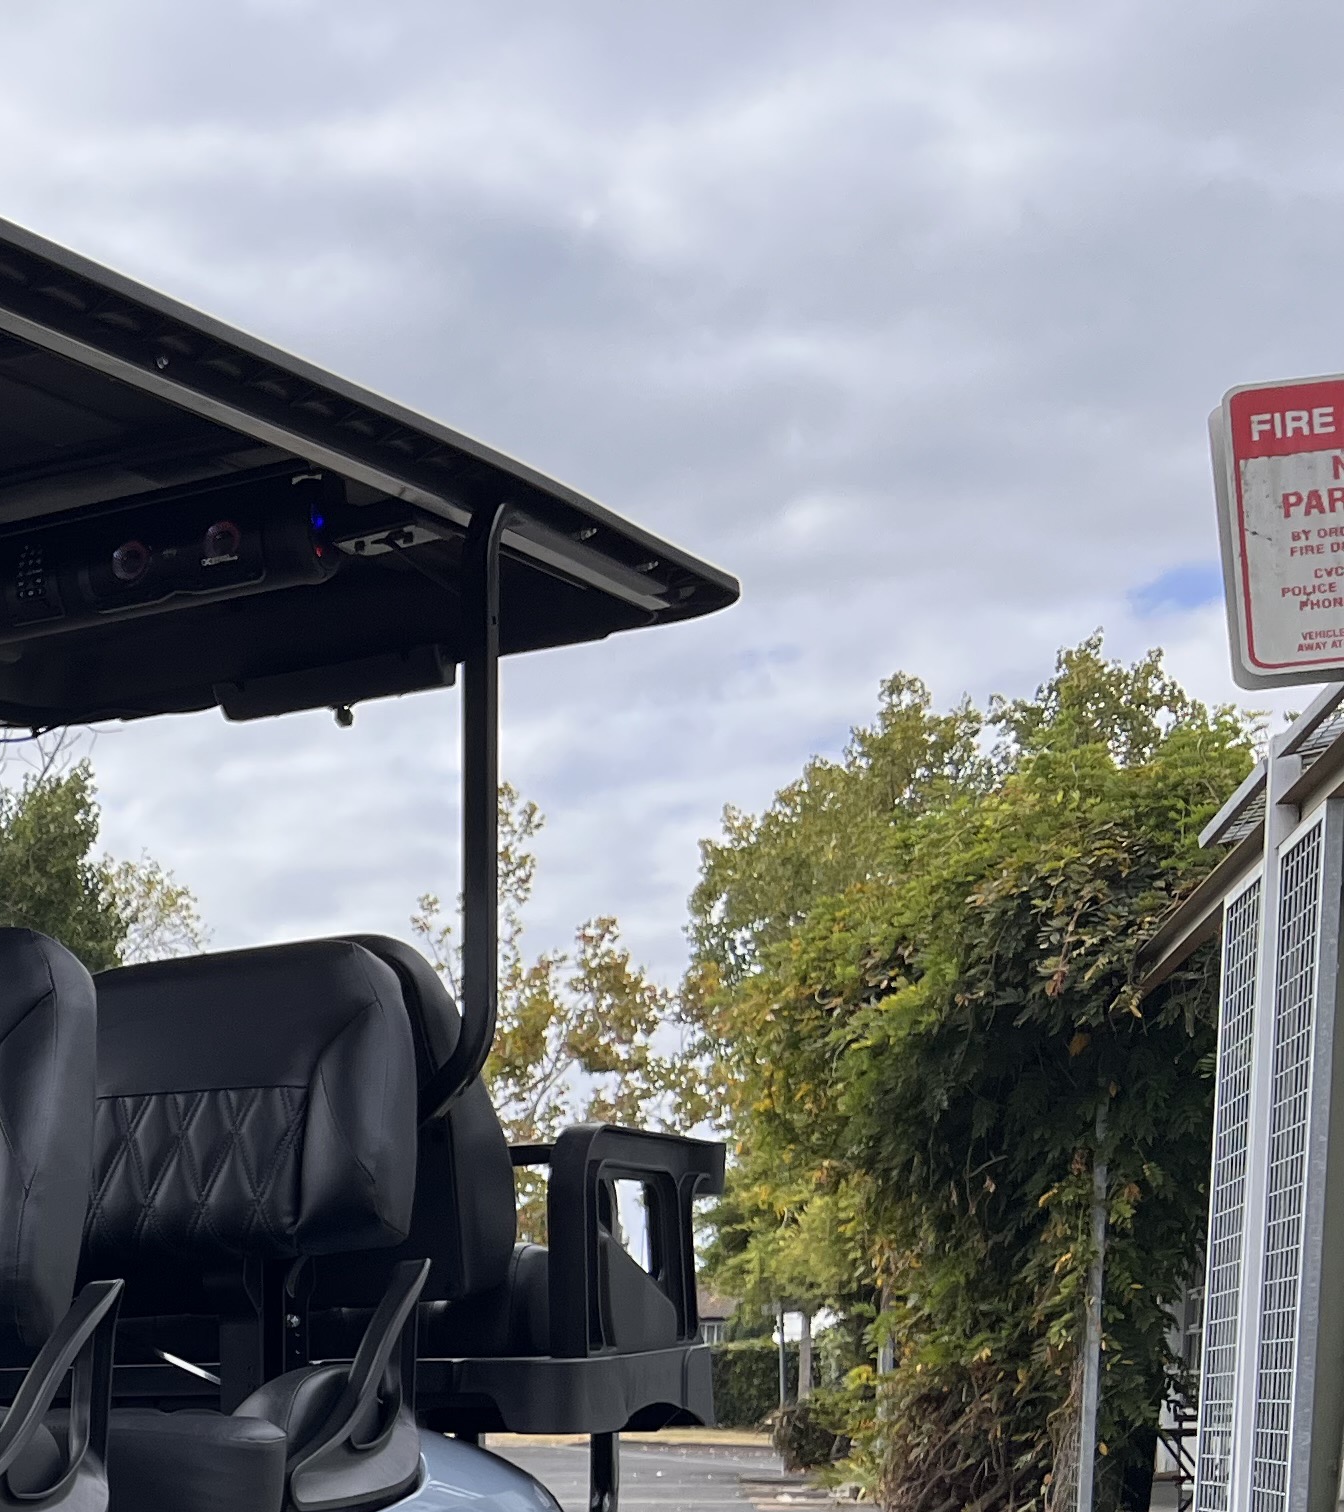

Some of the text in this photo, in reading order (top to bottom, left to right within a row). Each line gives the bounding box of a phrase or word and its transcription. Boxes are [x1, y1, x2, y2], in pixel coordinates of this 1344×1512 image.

[1250, 407, 1335, 441] FIRE
[1291, 530, 1312, 542] BY
[1290, 543, 1325, 557] FIRE
[1281, 582, 1337, 598] POLICE
[1297, 639, 1343, 653] AWAY AT
